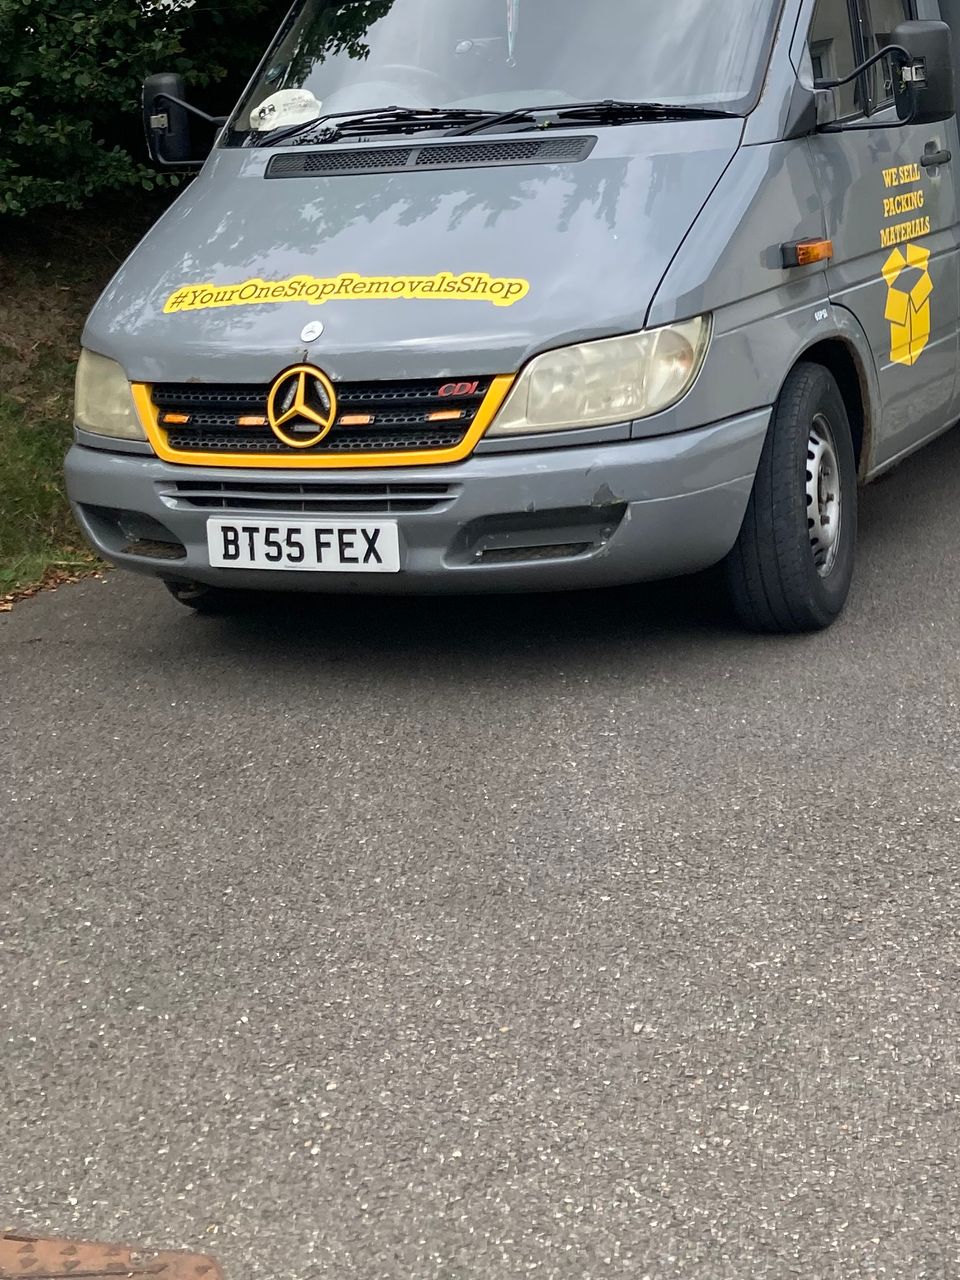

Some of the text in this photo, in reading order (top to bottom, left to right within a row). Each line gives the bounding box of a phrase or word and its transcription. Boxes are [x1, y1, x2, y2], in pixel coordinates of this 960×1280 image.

[882, 163, 921, 188] WE SELL
[883, 190, 924, 218] PACKING
[880, 216, 931, 249] MATERIALS
[169, 276, 523, 311] #YourOneStopRemovalsShop
[438, 381, 479, 397] CDI
[220, 526, 383, 564] BT55 FEX
